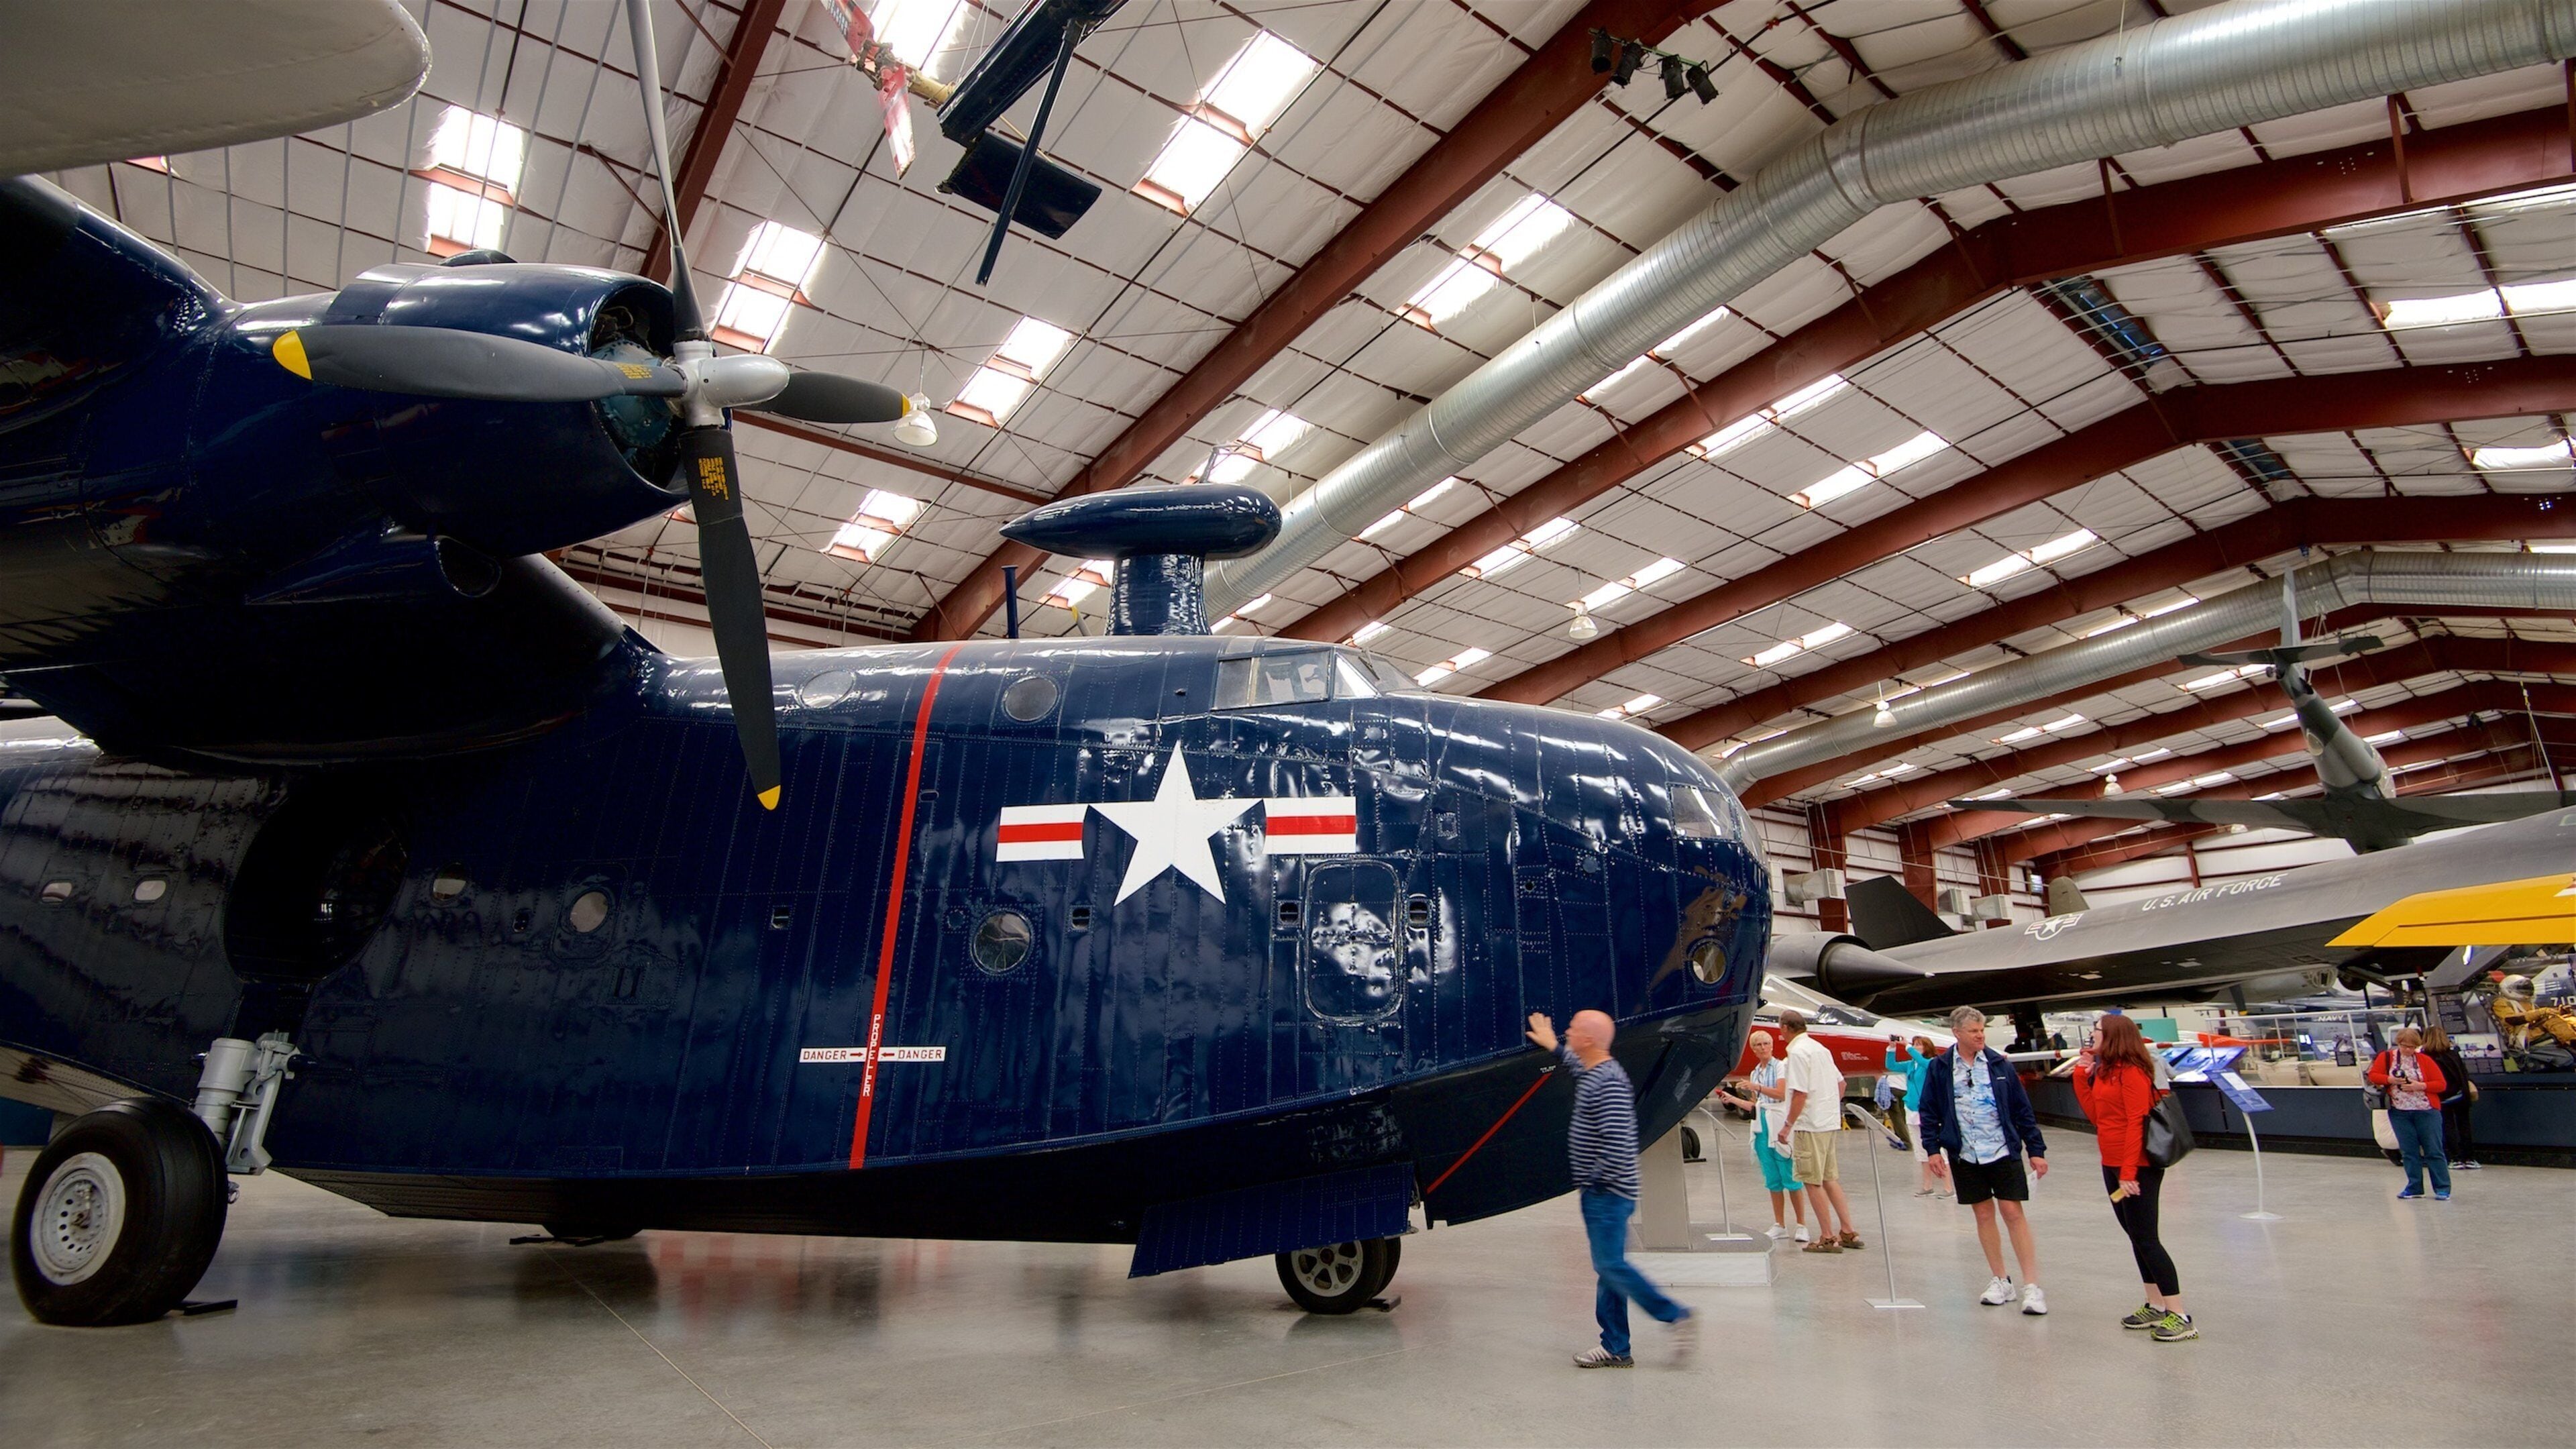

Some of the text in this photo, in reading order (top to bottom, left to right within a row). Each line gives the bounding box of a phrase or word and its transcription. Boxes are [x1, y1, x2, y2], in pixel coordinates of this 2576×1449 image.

[2178, 888, 2214, 904] AIR
[2216, 873, 2288, 898] FORCE
[2318, 1014, 2344, 1022] NAVY
[803, 1050, 847, 1060] DANGER
[862, 1014, 881, 1097] PROPELLER
[898, 1049, 943, 1059] DANGER
